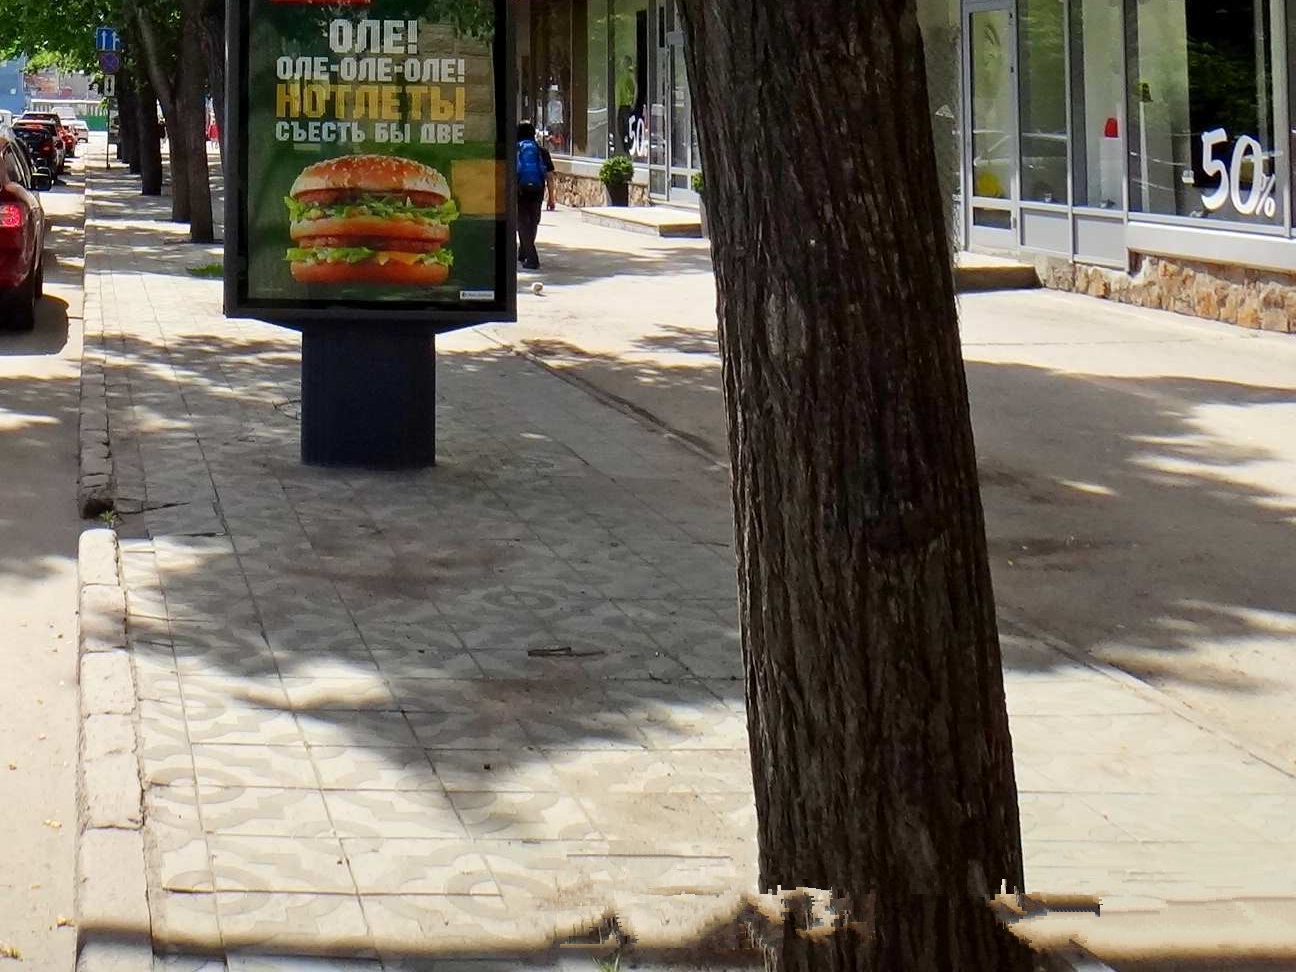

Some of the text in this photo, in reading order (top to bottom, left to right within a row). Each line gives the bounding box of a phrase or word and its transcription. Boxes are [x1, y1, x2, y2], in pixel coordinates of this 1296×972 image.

[329, 18, 418, 54] ОЛЕ!
[276, 56, 465, 83] ОЛЕ-ОЛЕ-ОЛЕ!
[275, 121, 465, 144] СЪЕСТЬ БЫ ДВЕ
[1201, 127, 1276, 218] 50%
